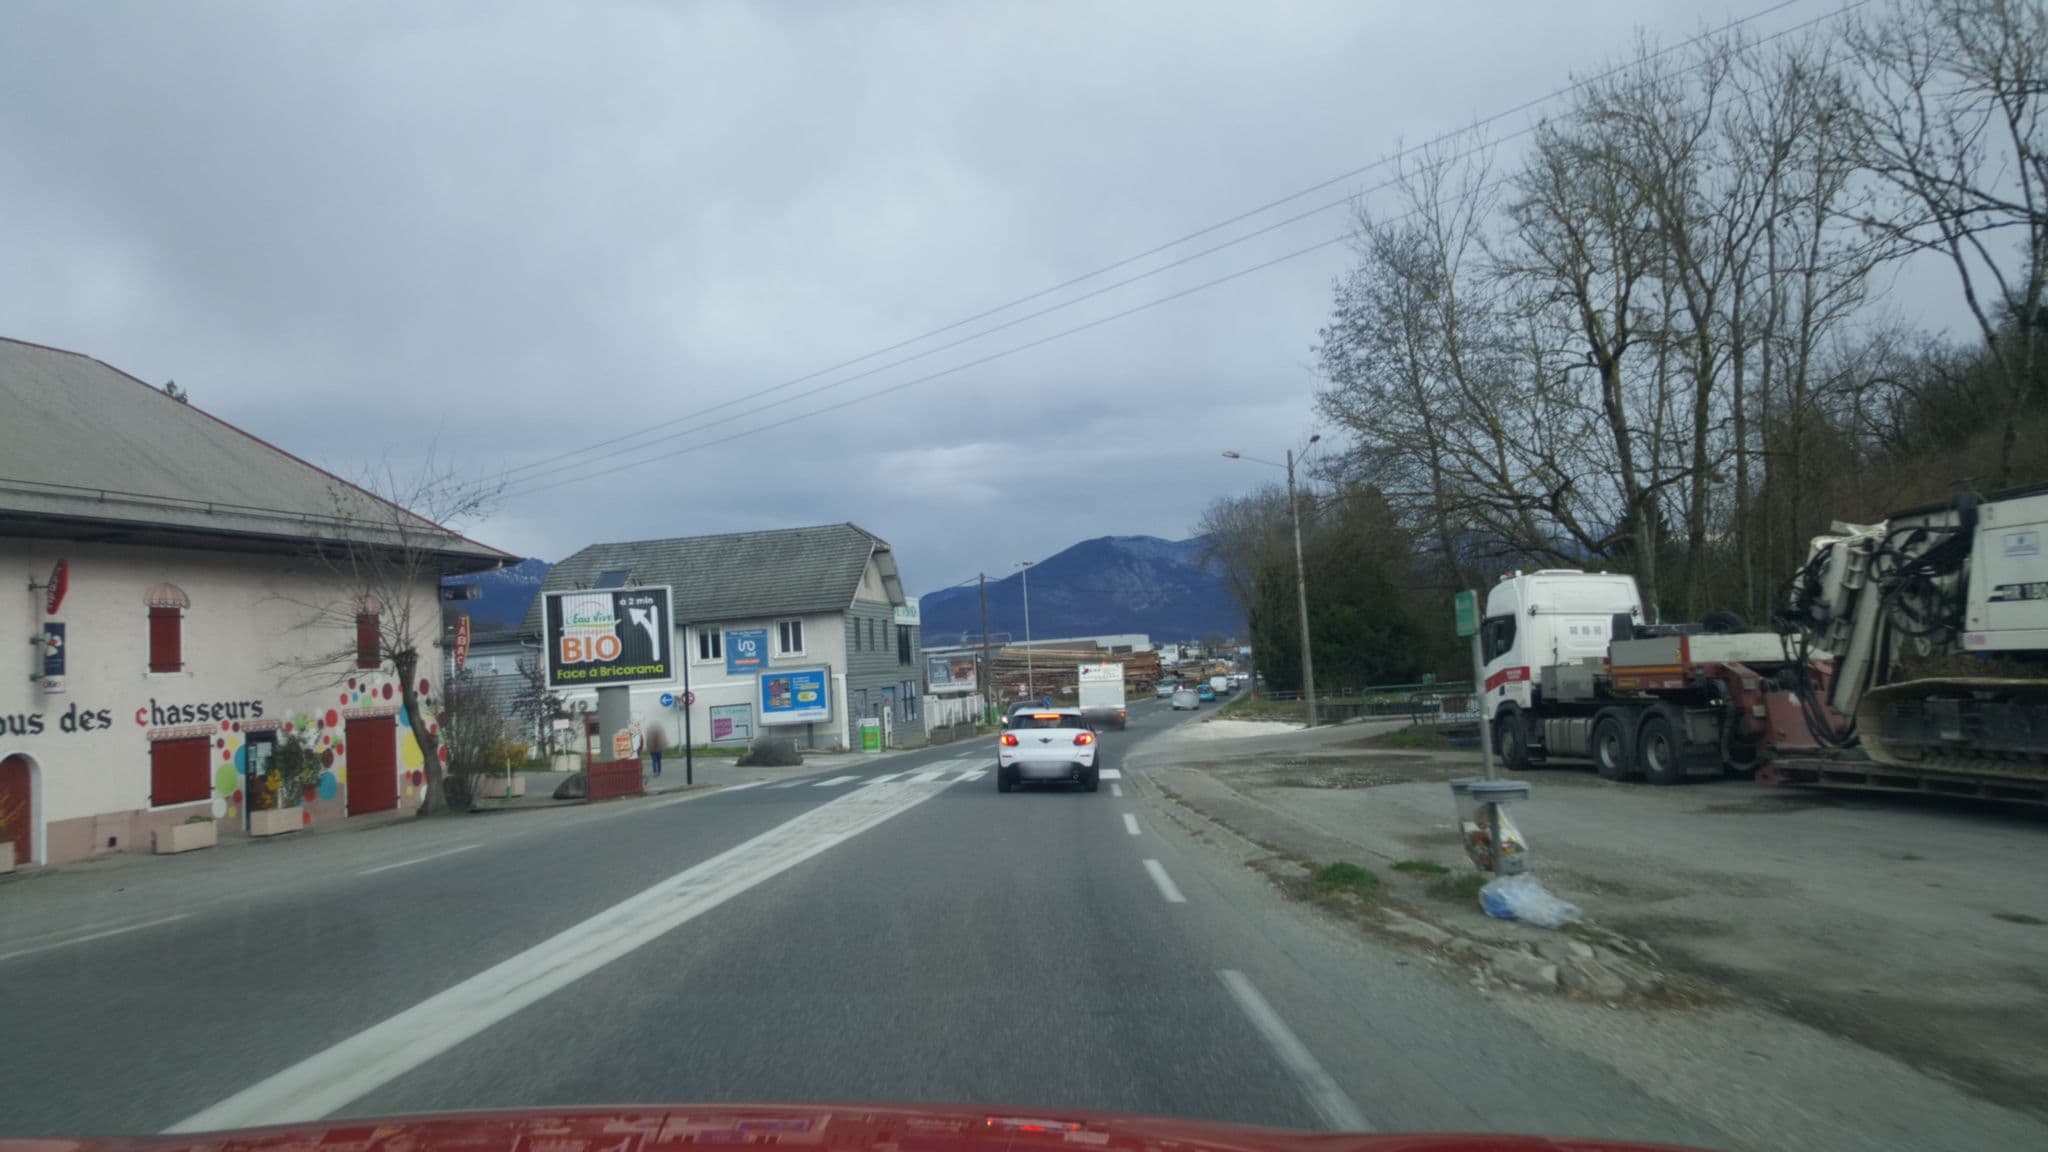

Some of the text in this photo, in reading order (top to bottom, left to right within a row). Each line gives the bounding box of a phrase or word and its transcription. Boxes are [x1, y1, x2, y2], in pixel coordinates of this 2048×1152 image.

[636, 596, 654, 605] min
[457, 616, 467, 665] TABAC
[561, 635, 622, 663] BIO
[557, 669, 586, 680] Face
[600, 664, 664, 677] Bricorama
[59, 703, 112, 733] des
[135, 698, 264, 726] chasseurs
